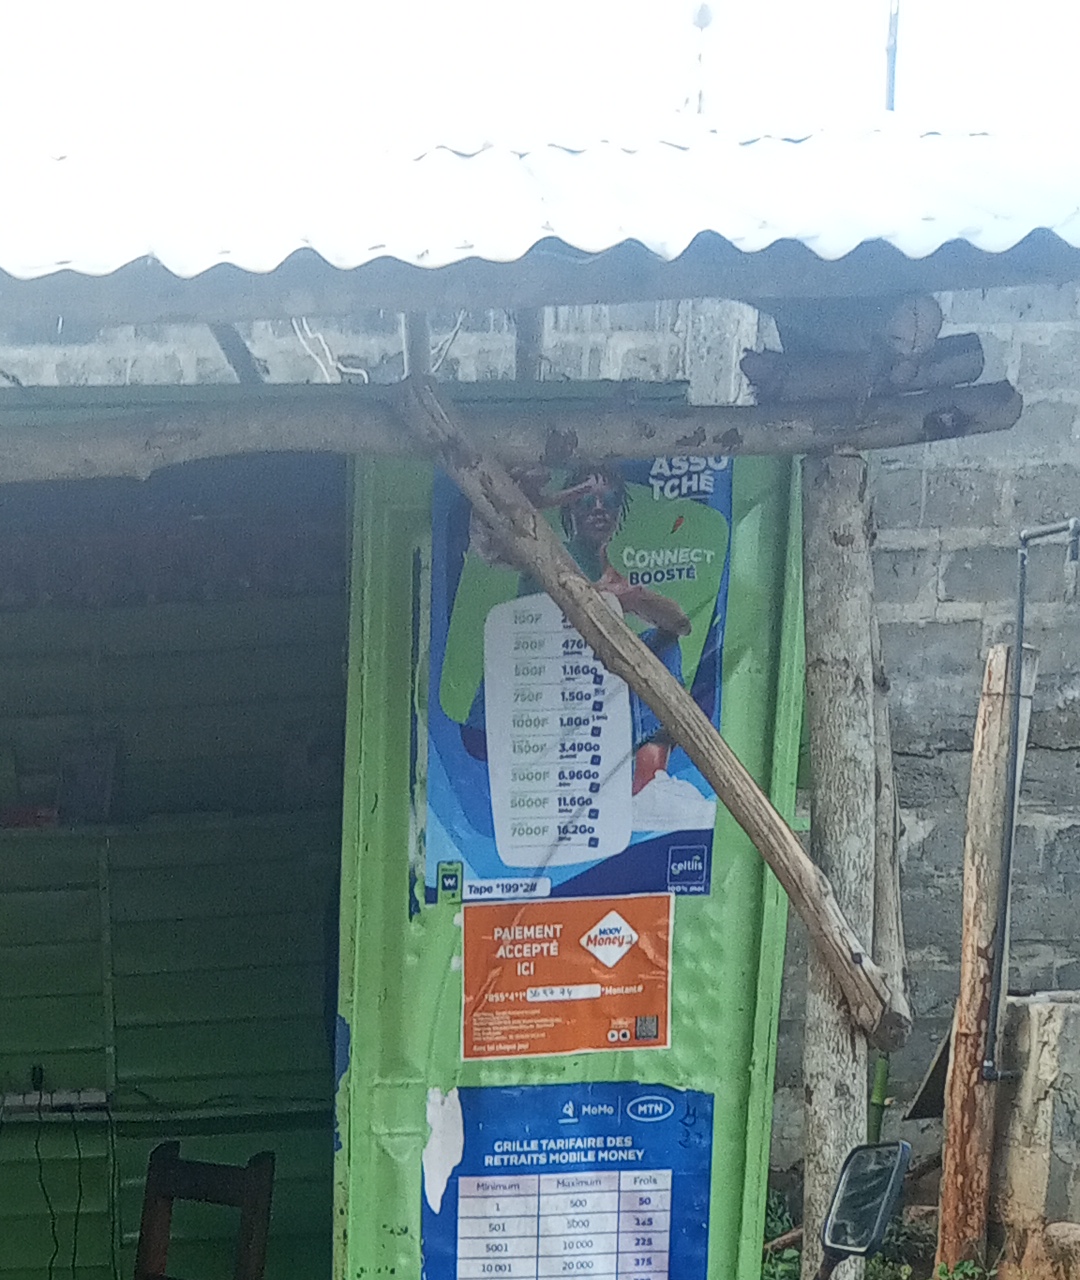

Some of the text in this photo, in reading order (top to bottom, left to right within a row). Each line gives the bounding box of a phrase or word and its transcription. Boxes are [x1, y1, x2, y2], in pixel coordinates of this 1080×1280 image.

[649, 469, 714, 500] TCHÉ
[623, 547, 715, 568] CONNECT
[629, 564, 696, 585] BOOSTÉ
[511, 825, 550, 837] 7000F
[671, 859, 703, 873] celtiis
[468, 884, 494, 894] Tape
[493, 924, 564, 941] PAIEMENT
[586, 935, 629, 948] Money
[495, 940, 559, 958] ACCEPTÉ
[517, 962, 535, 976] ICI
[581, 1104, 614, 1116] MoMo
[637, 1103, 664, 1115] MTN
[494, 1136, 632, 1153] GRILLE TARIFAIRE DES
[484, 1148, 645, 1166] RETRAITS MOBILE MONEY
[476, 1181, 520, 1191] Minimum
[556, 1178, 602, 1188] Maximum
[638, 1197, 651, 1205] 50
[489, 1223, 506, 1232] 501
[486, 1243, 508, 1253] 5001
[563, 1240, 594, 1250] 10 000
[481, 1264, 512, 1273] 10 001
[562, 1260, 594, 1270] 20 000
